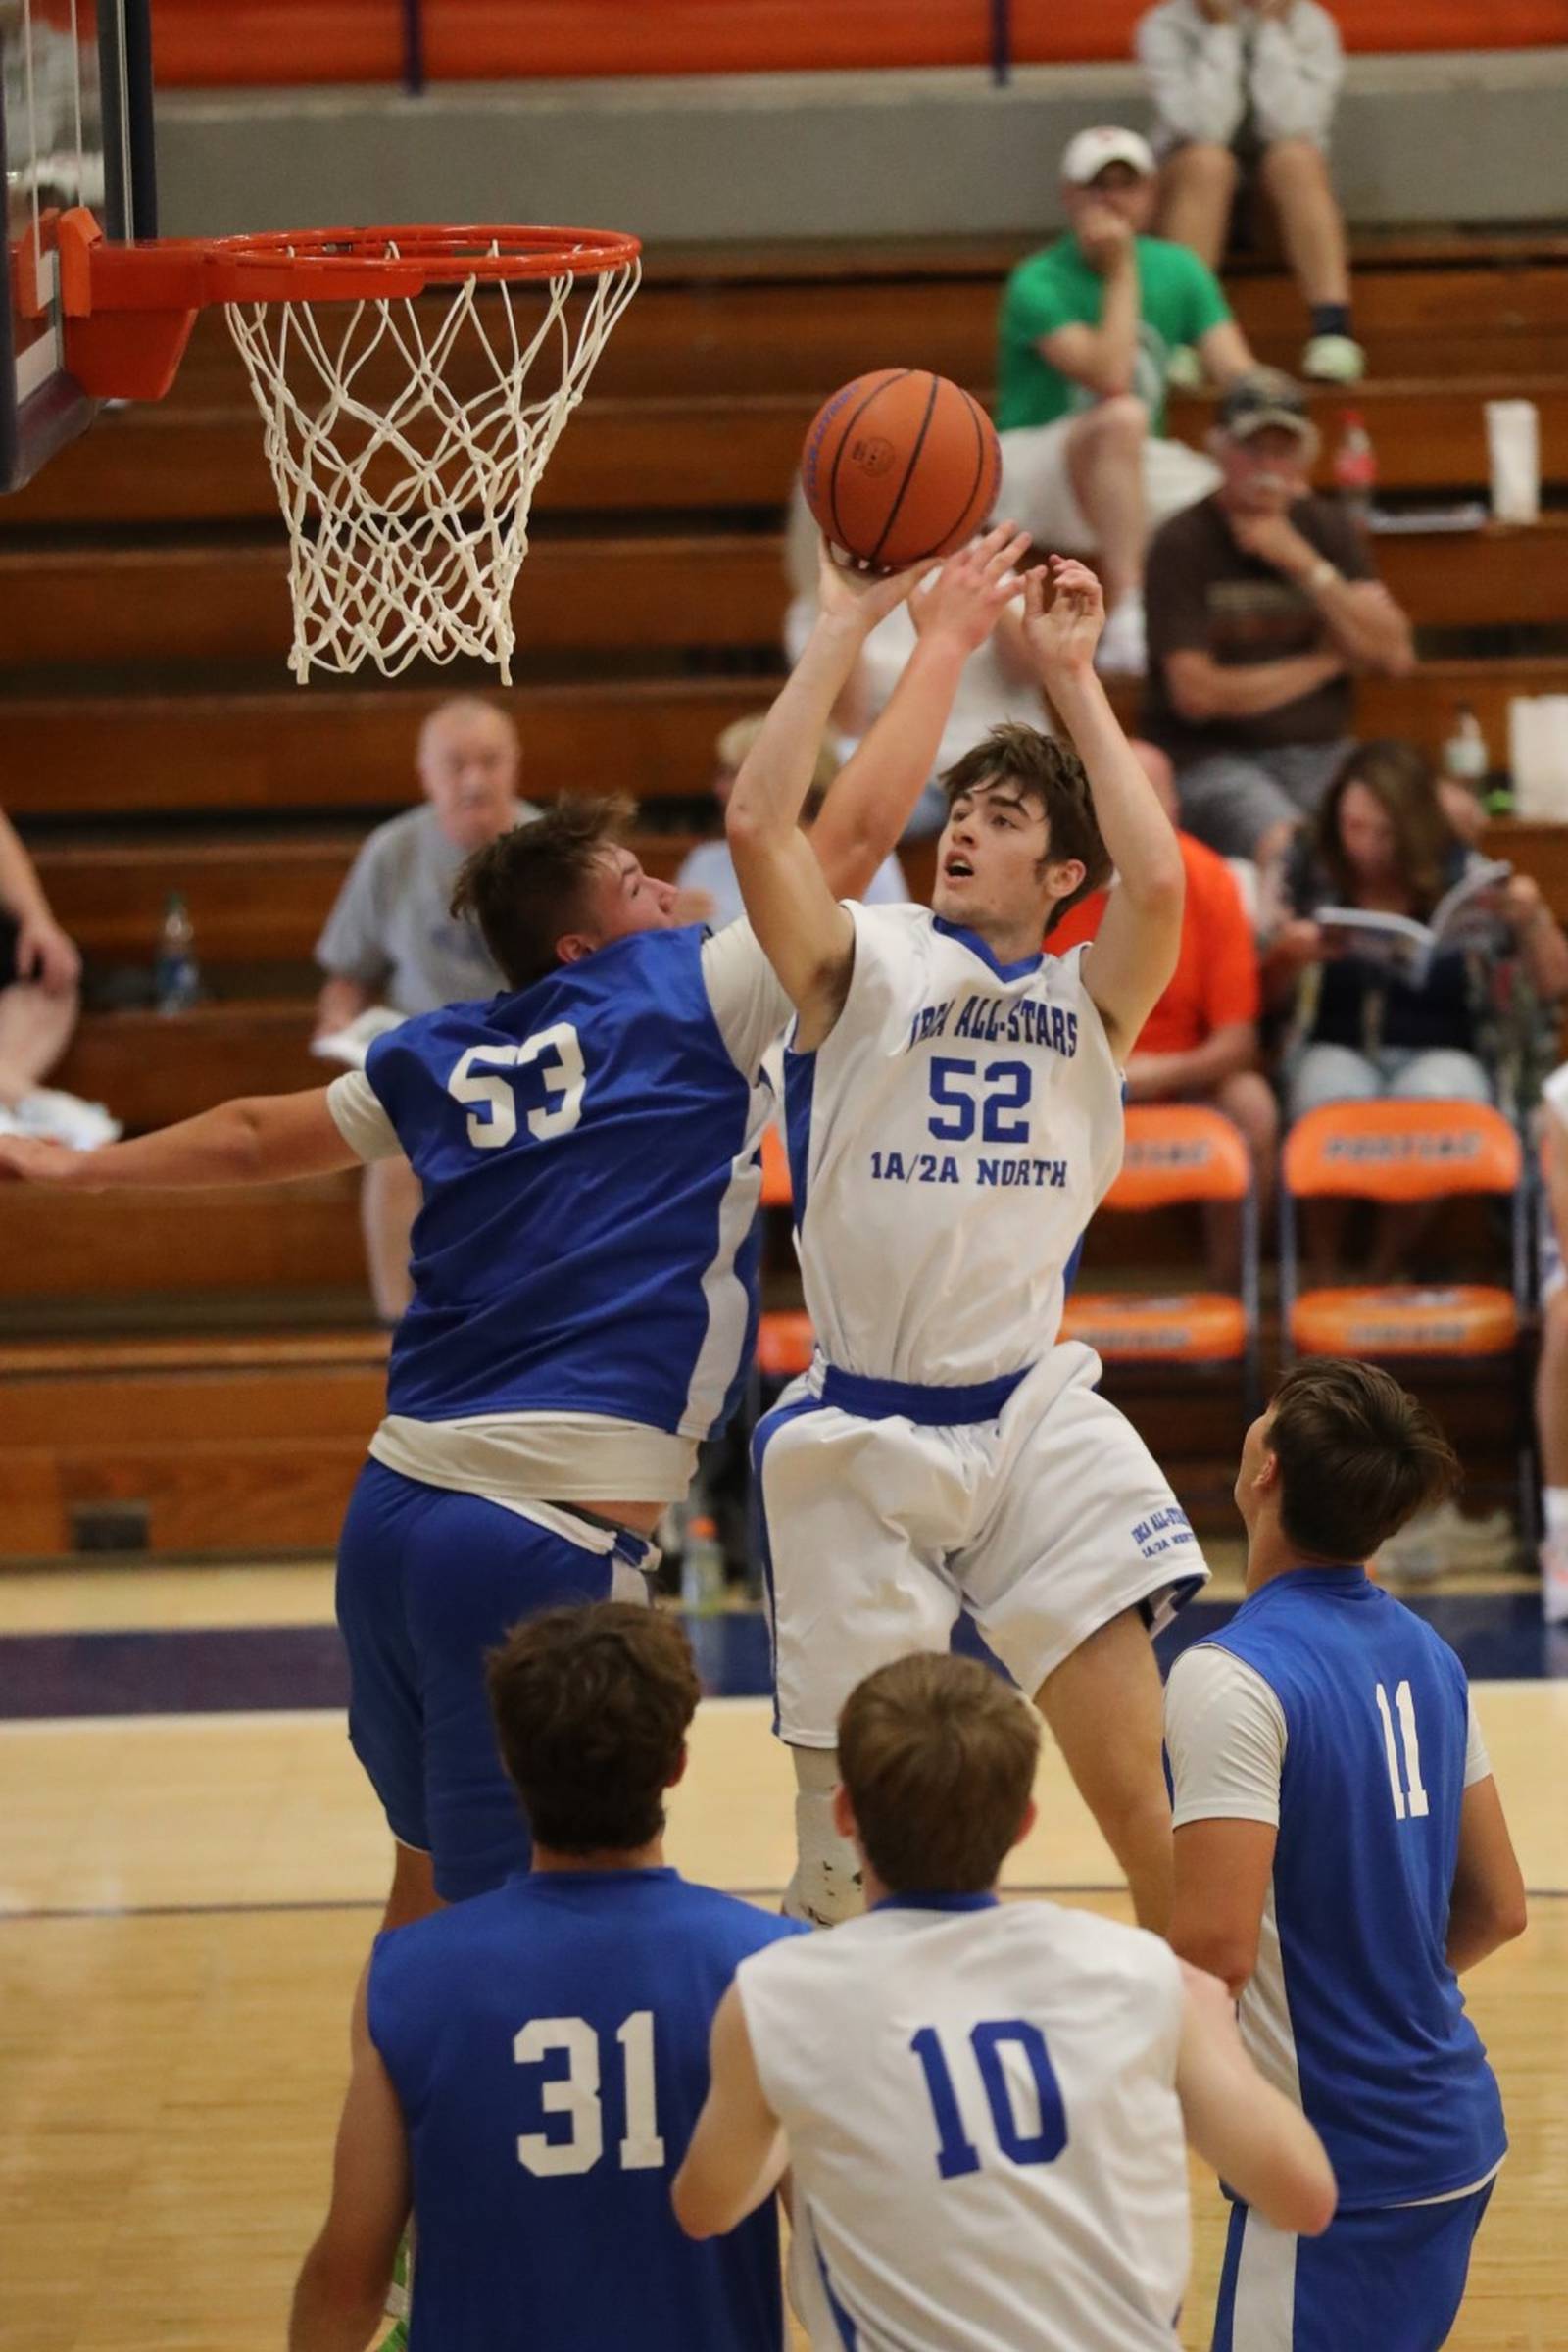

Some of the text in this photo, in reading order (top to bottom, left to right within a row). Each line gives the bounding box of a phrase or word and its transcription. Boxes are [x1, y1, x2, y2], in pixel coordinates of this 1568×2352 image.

[448, 1022, 587, 1149] 53
[954, 995, 1078, 1058] ALL-STARS
[928, 1056, 1032, 1143] 52
[870, 1152, 1068, 1188] 1A/2A NORTH
[1376, 1680, 1430, 1820] 11
[514, 2011, 665, 2178] 31
[910, 2019, 1069, 2180] 10
